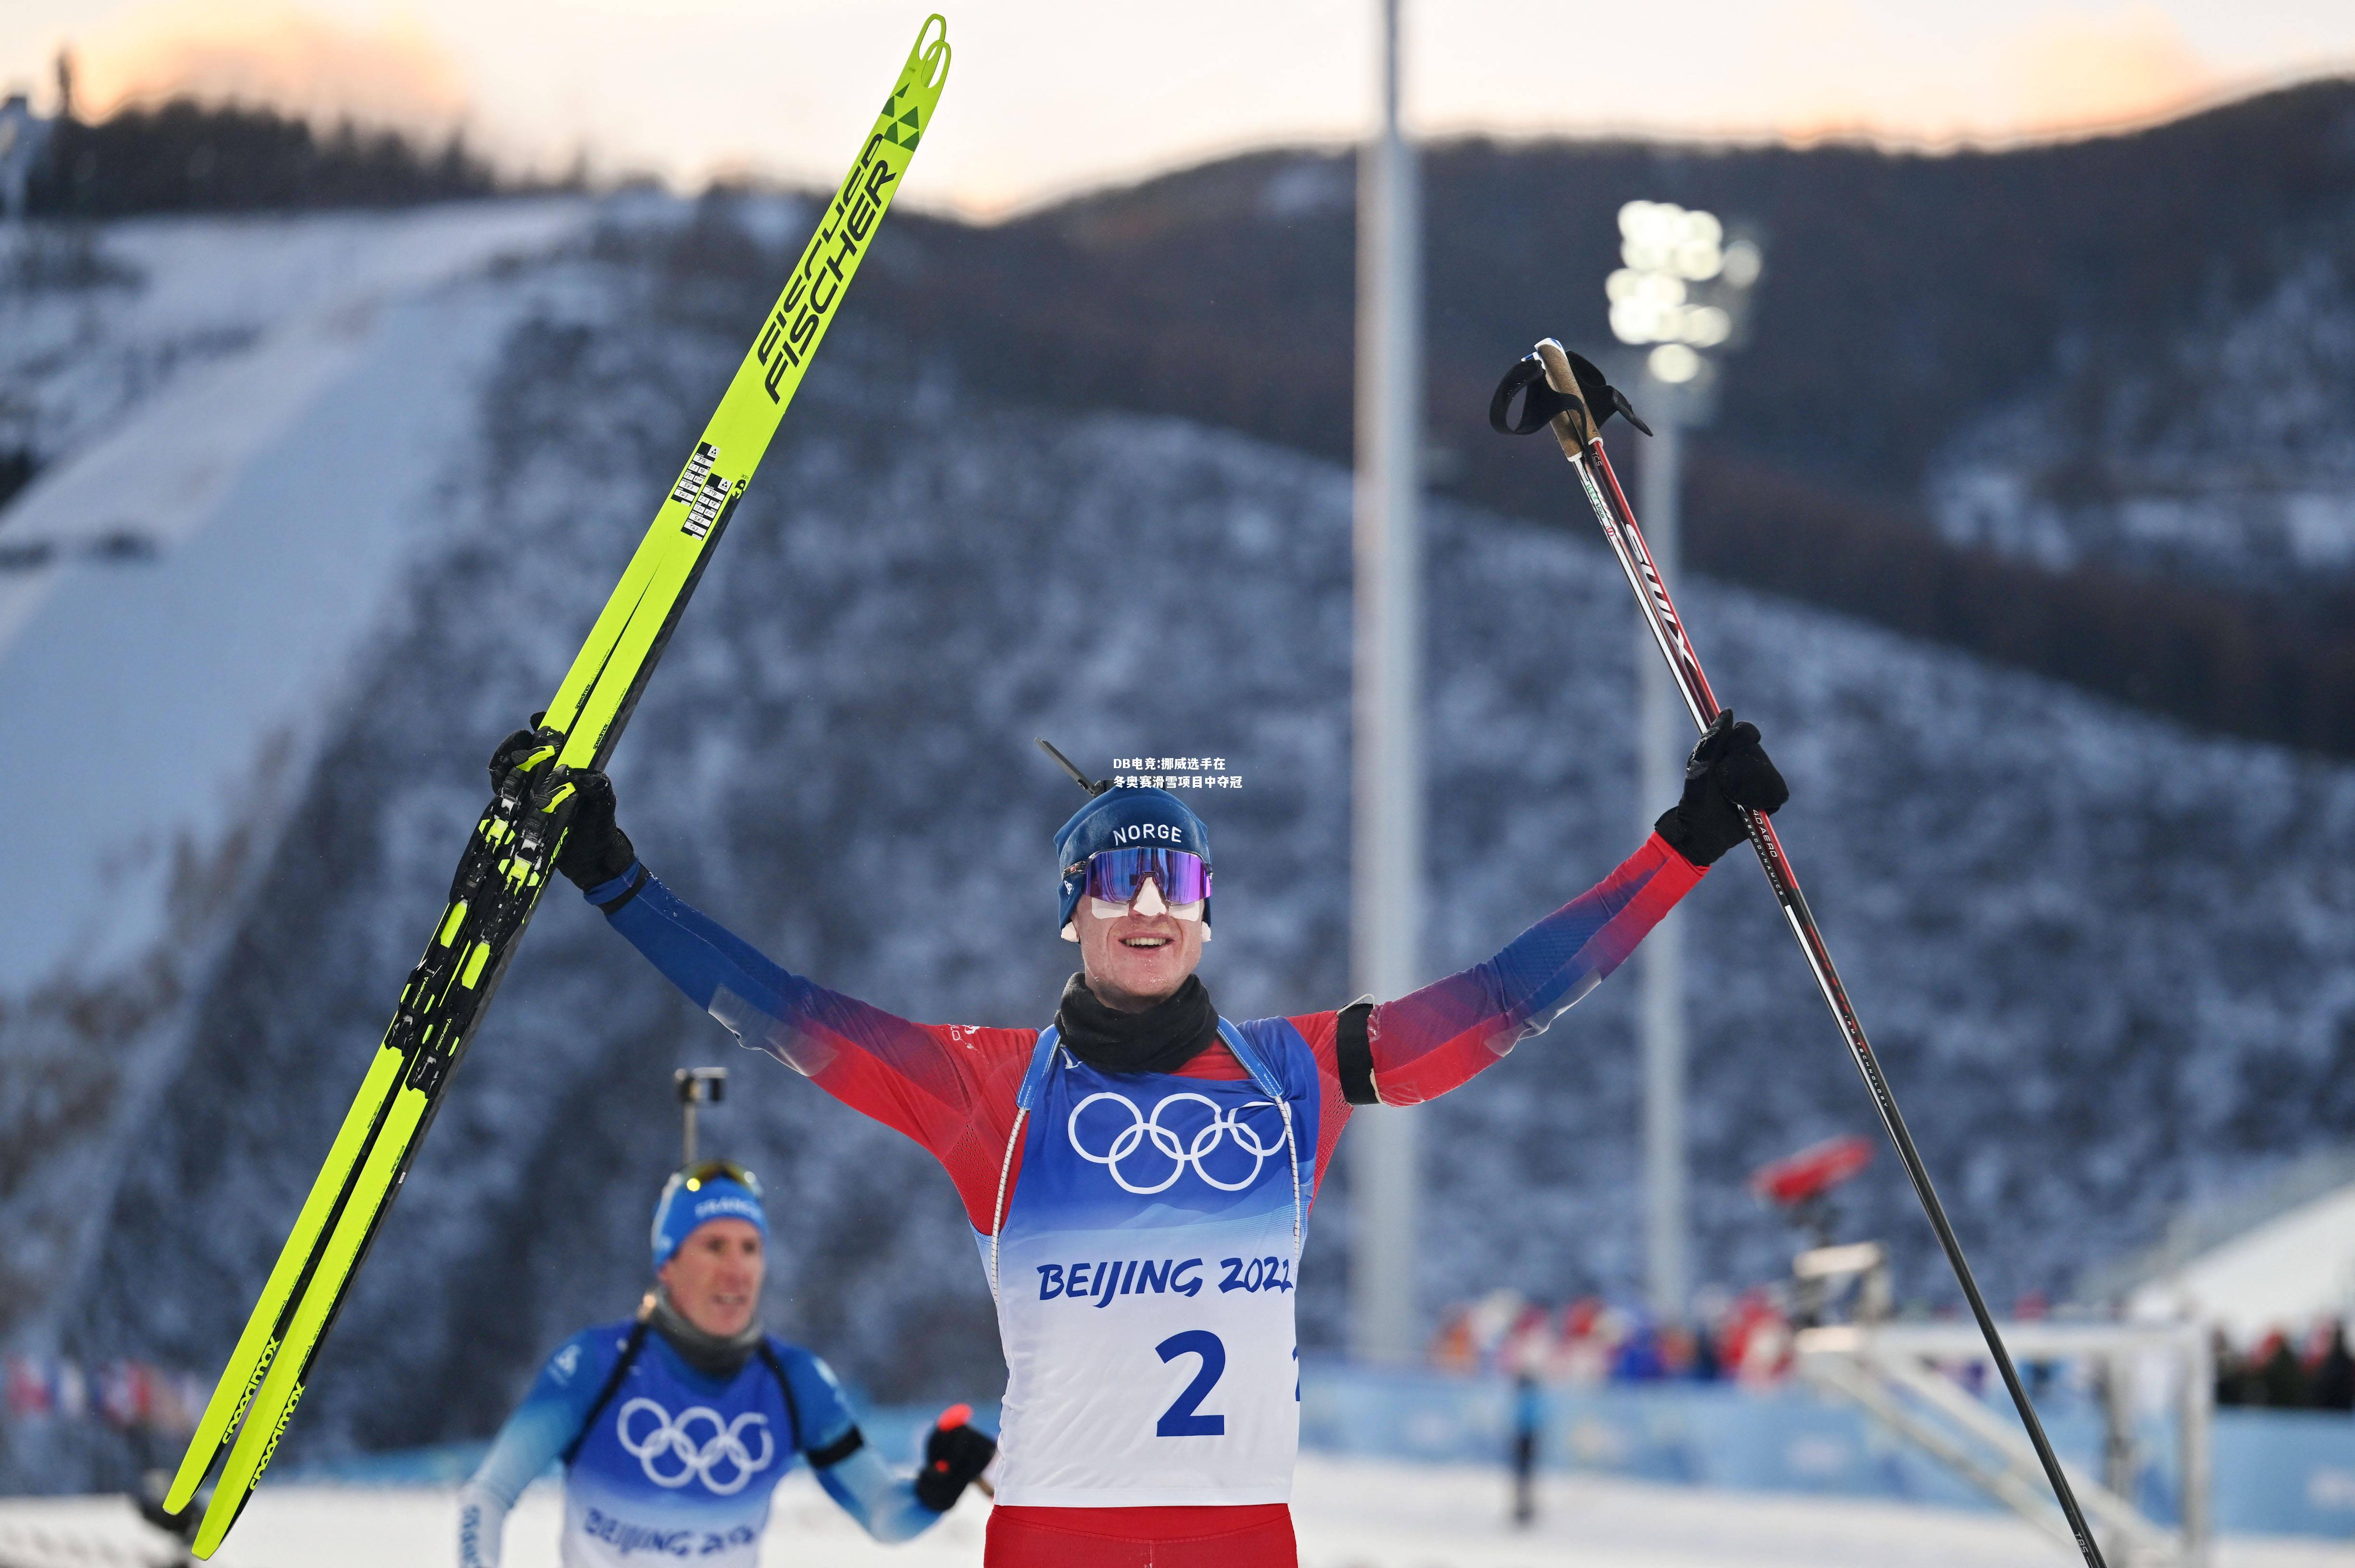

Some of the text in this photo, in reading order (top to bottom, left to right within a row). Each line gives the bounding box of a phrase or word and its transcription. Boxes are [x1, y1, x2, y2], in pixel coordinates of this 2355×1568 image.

[764, 160, 897, 405] FISCHER
[1592, 451, 1603, 466] TCS
[1113, 823, 1182, 846] NORGE
[1759, 826, 1778, 858] AERO
[1744, 818, 1783, 896] AERODYNAMICS
[412, 981, 426, 1008] FISCHER
[436, 1022, 449, 1051] FISCHER
[1036, 1257, 1294, 1308] BEIJING 2022
[1155, 1330, 1226, 1437] 2
[2075, 1531, 2089, 1554] TBS
